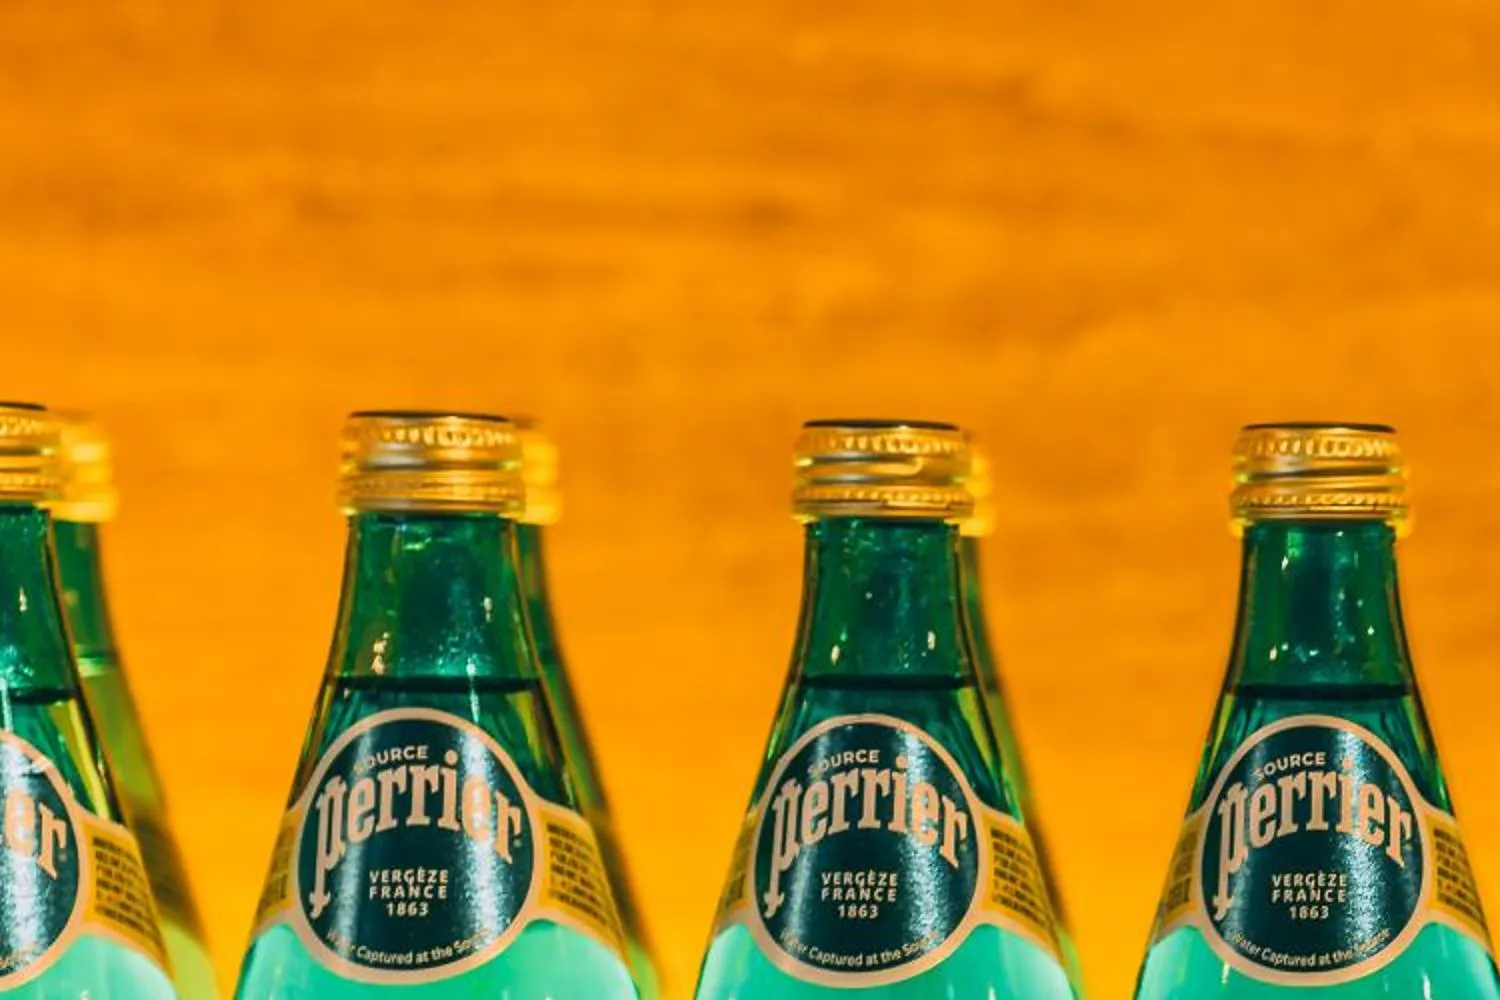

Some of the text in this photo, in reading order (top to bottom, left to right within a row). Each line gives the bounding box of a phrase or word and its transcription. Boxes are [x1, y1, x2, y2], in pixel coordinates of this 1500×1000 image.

[1253, 751, 1327, 781] SOURCE
[369, 866, 449, 884] VERGÈZE
[821, 868, 898, 887] VERGÈZE
[1271, 869, 1347, 888] VERGÈZE
[369, 885, 448, 900] FRANCE
[821, 887, 897, 902] FRANCE
[1271, 888, 1346, 904] FRANCE
[386, 901, 429, 917] 1863
[837, 904, 878, 919] 1863
[1289, 905, 1330, 920] 1863
[356, 944, 413, 964] Captured
[416, 951, 429, 964] at
[431, 946, 453, 960] the
[809, 946, 863, 967] Captured
[865, 954, 878, 967] at
[880, 949, 901, 963] the
[1261, 947, 1316, 967] Captured
[1318, 954, 1331, 966] at
[1332, 948, 1353, 961] the
